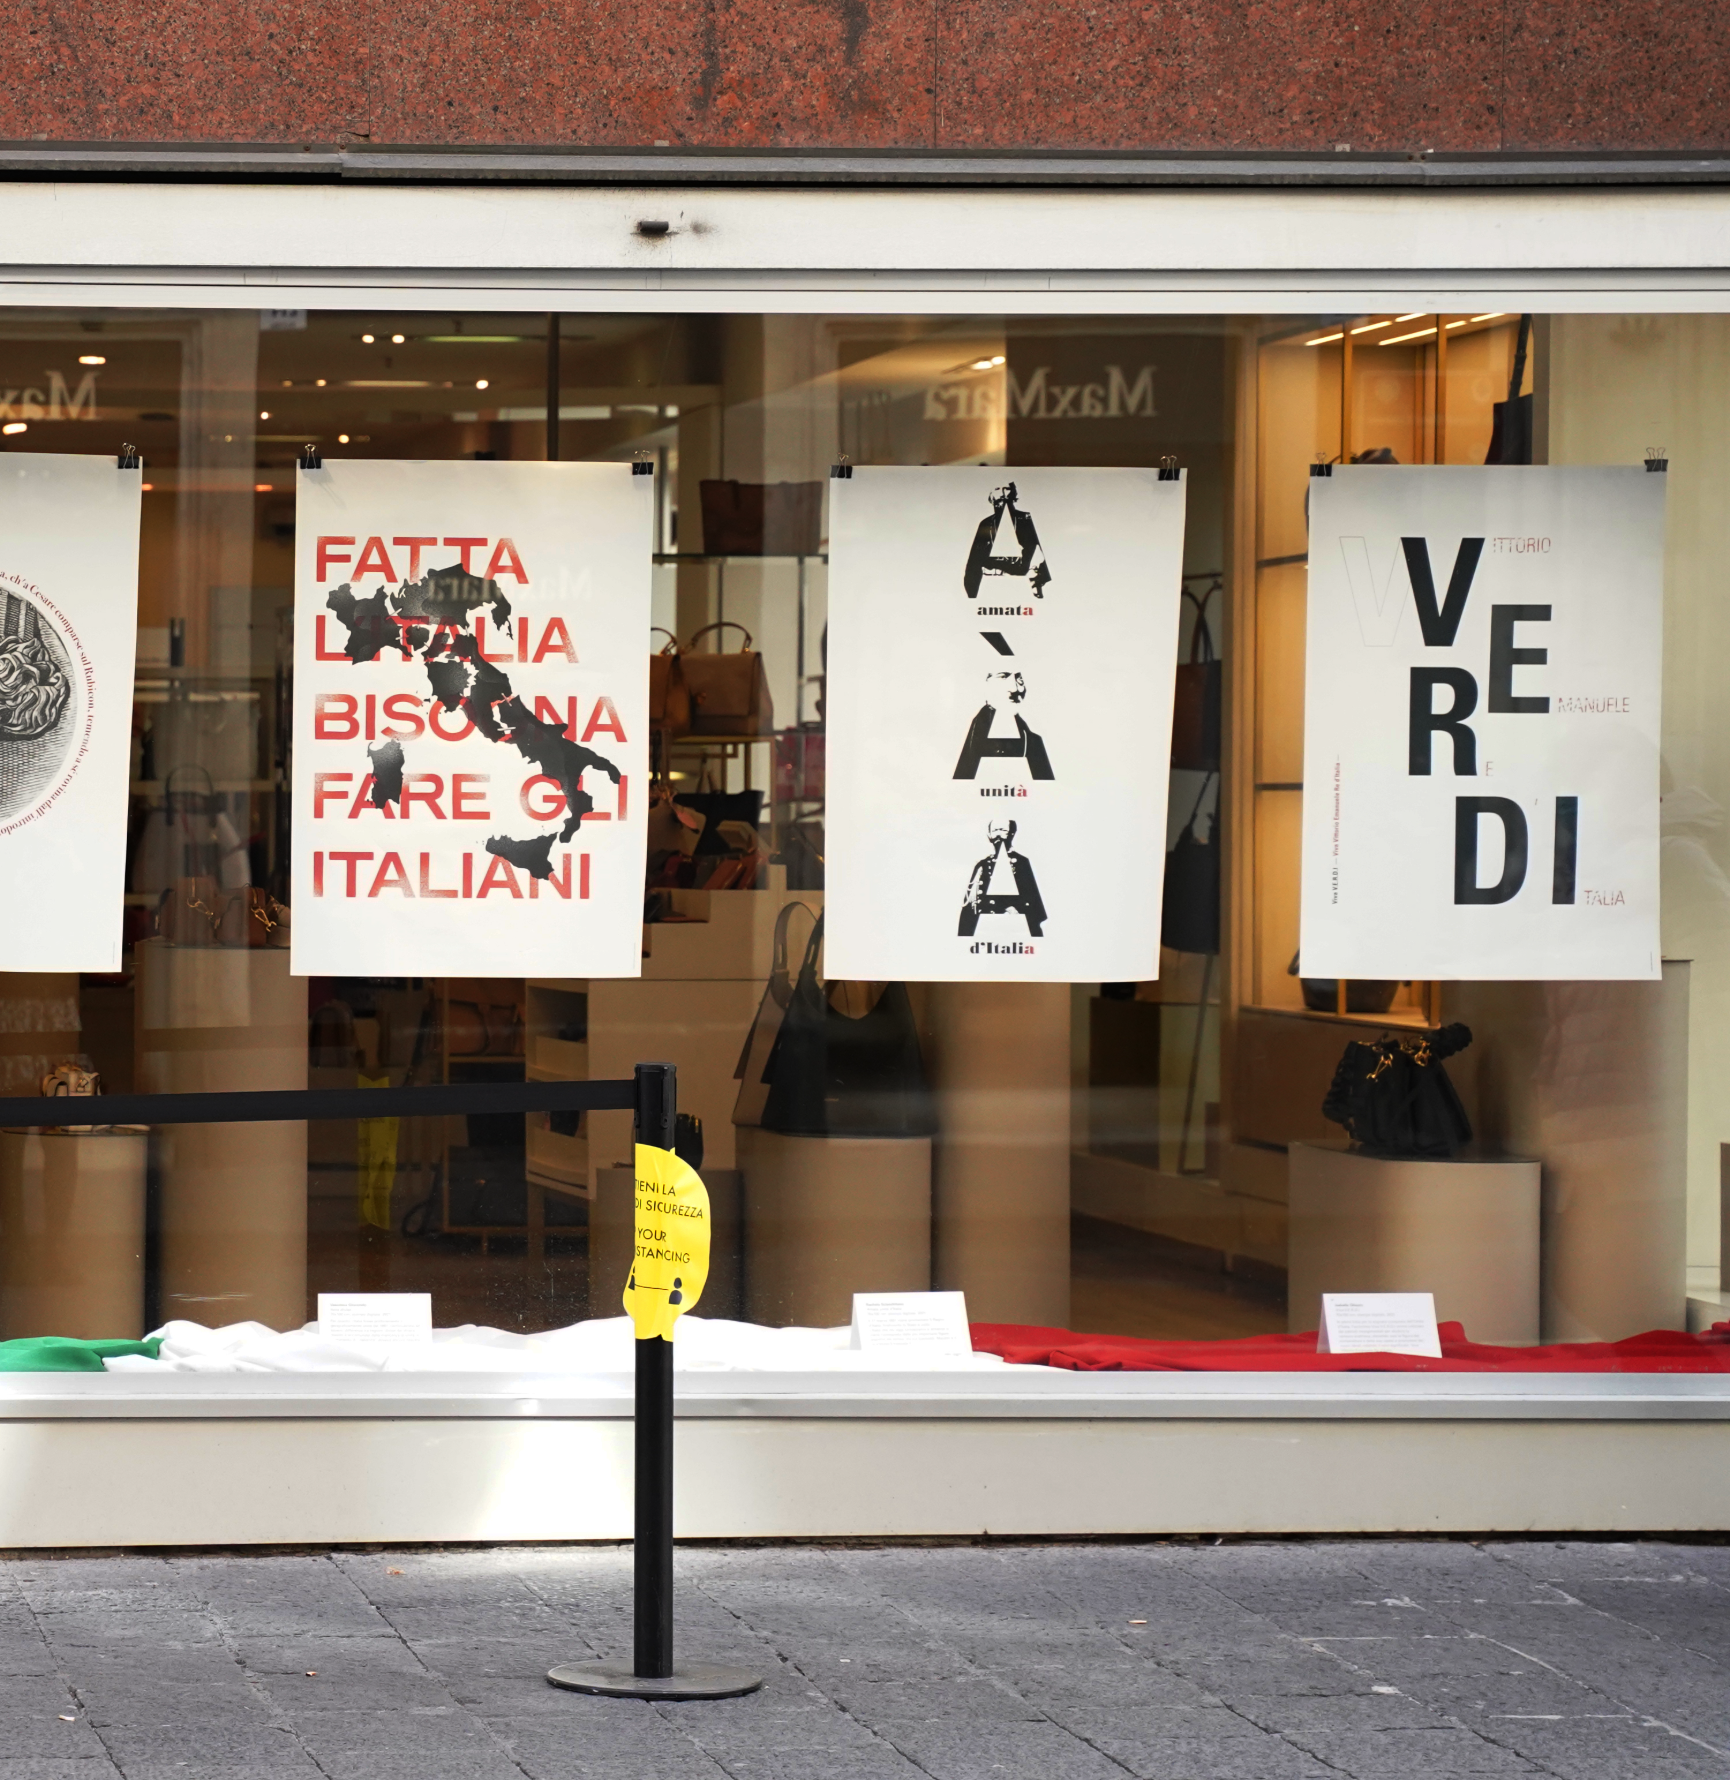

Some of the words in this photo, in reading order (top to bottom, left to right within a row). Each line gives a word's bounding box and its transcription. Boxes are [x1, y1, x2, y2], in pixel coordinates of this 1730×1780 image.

[316, 536, 529, 585] FATTA
[976, 604, 1035, 617] amata
[314, 693, 628, 743] BISONA
[313, 773, 491, 821] FARE
[979, 784, 1028, 798] unità
[312, 851, 591, 899] ITALIANI
[969, 941, 1036, 955] d'Italia
[662, 1183, 676, 1197] LA
[645, 1199, 704, 1219] SICUREZZA
[637, 1227, 667, 1243] YOUR
